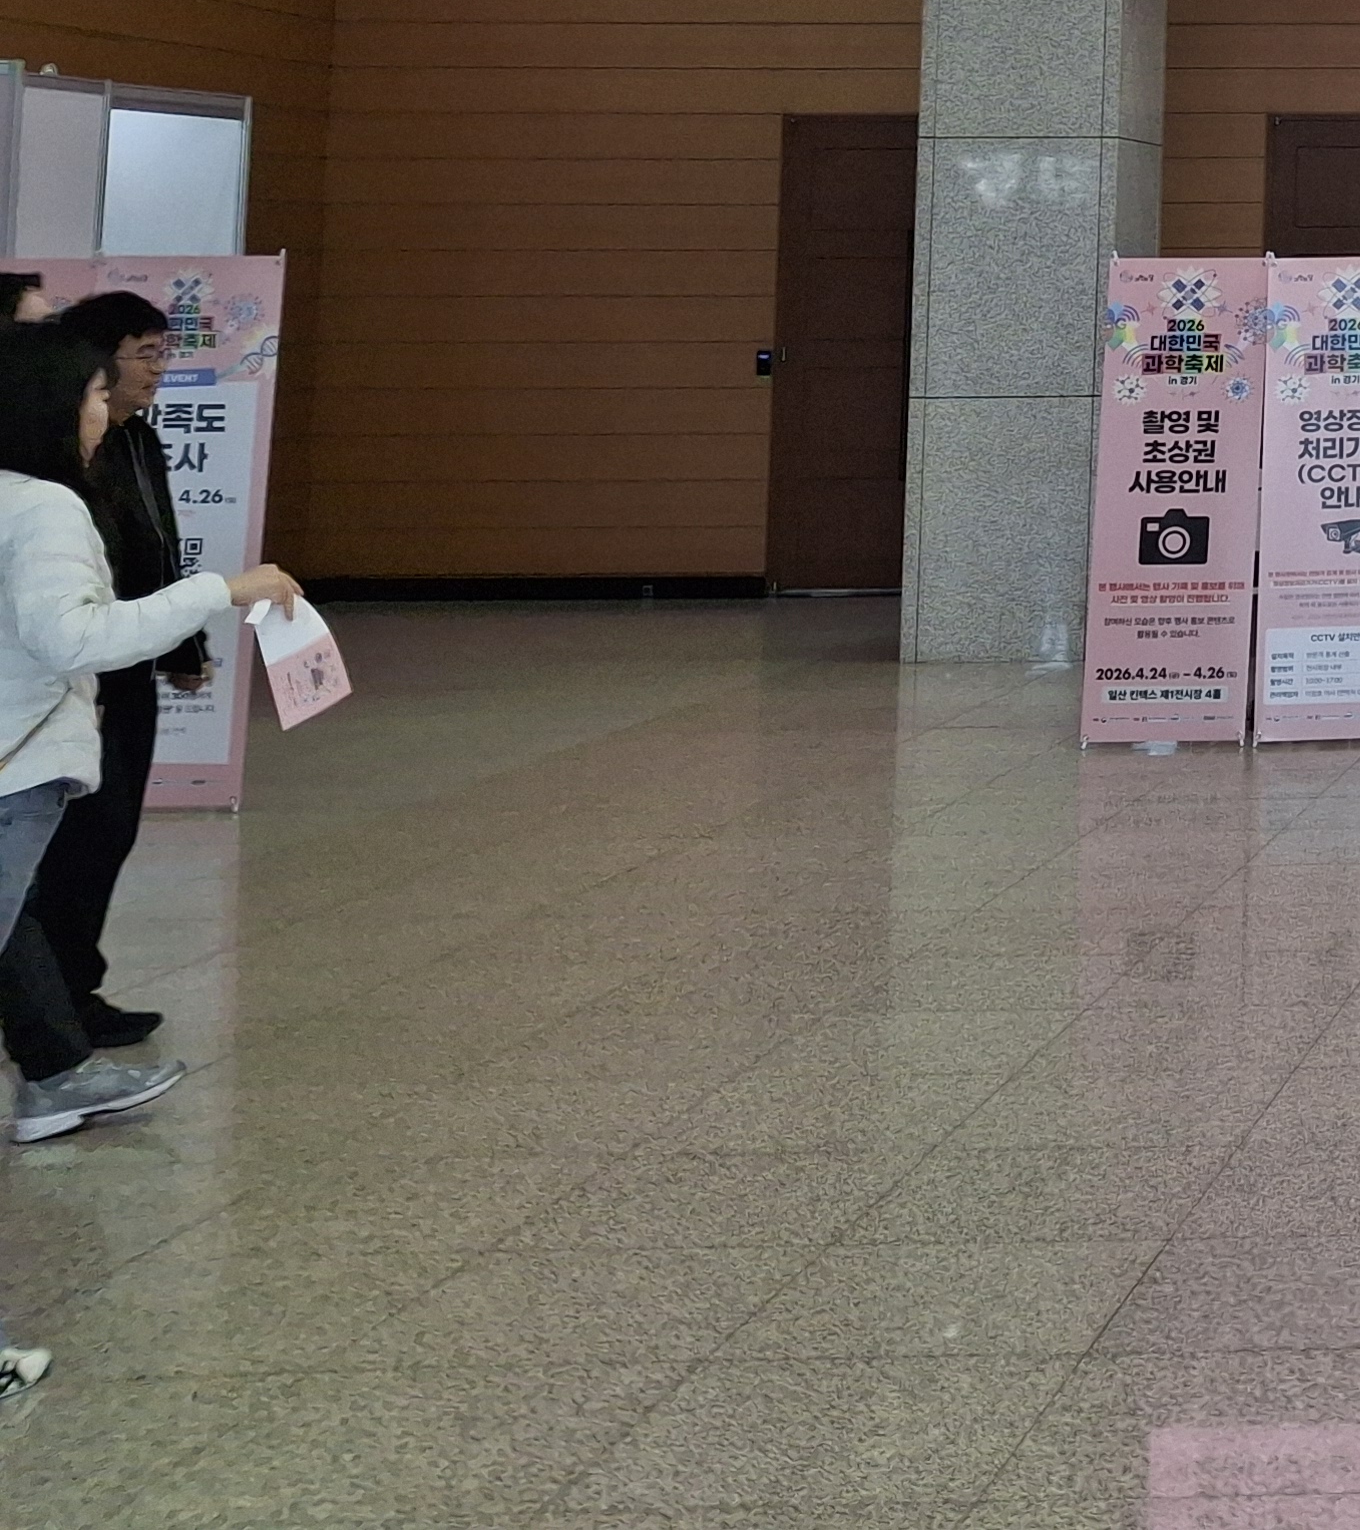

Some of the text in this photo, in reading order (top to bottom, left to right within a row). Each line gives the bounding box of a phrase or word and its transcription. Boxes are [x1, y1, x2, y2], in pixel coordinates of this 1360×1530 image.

[1167, 320, 1205, 332] 2026
[1150, 334, 1220, 352] 대한민국
[1143, 354, 1224, 373] 과학축제
[163, 374, 199, 384] EVENT
[1168, 376, 1198, 386] in 경기
[1331, 375, 1360, 385] in 경기
[1142, 410, 1220, 435] 촬영 및
[1142, 440, 1216, 463] 초상권
[1128, 469, 1227, 494] 사용안내
[178, 489, 223, 504] 4.26
[1111, 595, 1129, 604] 사진
[1141, 595, 1158, 604] 영상
[1161, 630, 1168, 638] 수
[1310, 633, 1336, 643] CCTV
[1095, 667, 1168, 681] 2026.4.24
[1193, 666, 1225, 680] 4.26
[1108, 688, 1222, 701] 일산 킨텍스 제1전시장 4홀
